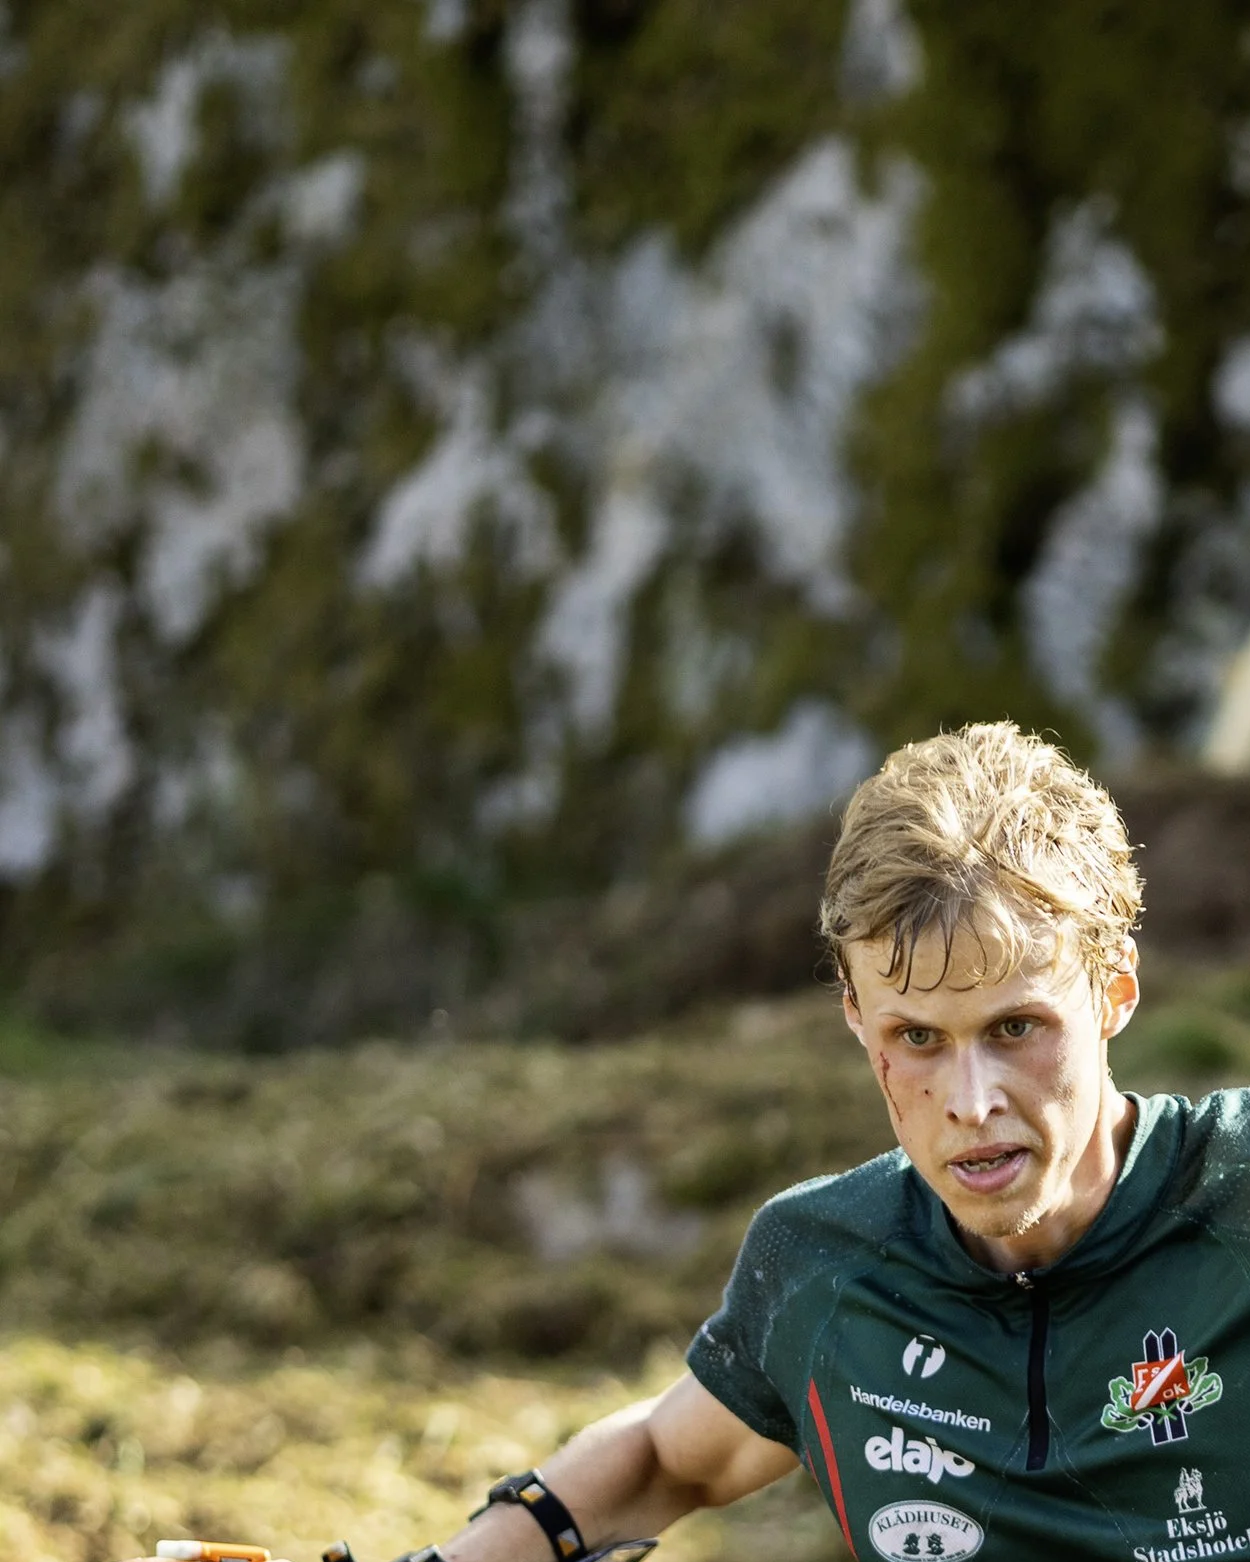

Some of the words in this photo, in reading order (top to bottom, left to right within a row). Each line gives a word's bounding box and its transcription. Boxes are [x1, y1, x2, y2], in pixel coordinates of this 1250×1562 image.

[850, 1385, 991, 1432] Handelsbanken
[876, 1509, 973, 1534] KLÄDHUSET
[1166, 1511, 1228, 1539] Eksjö
